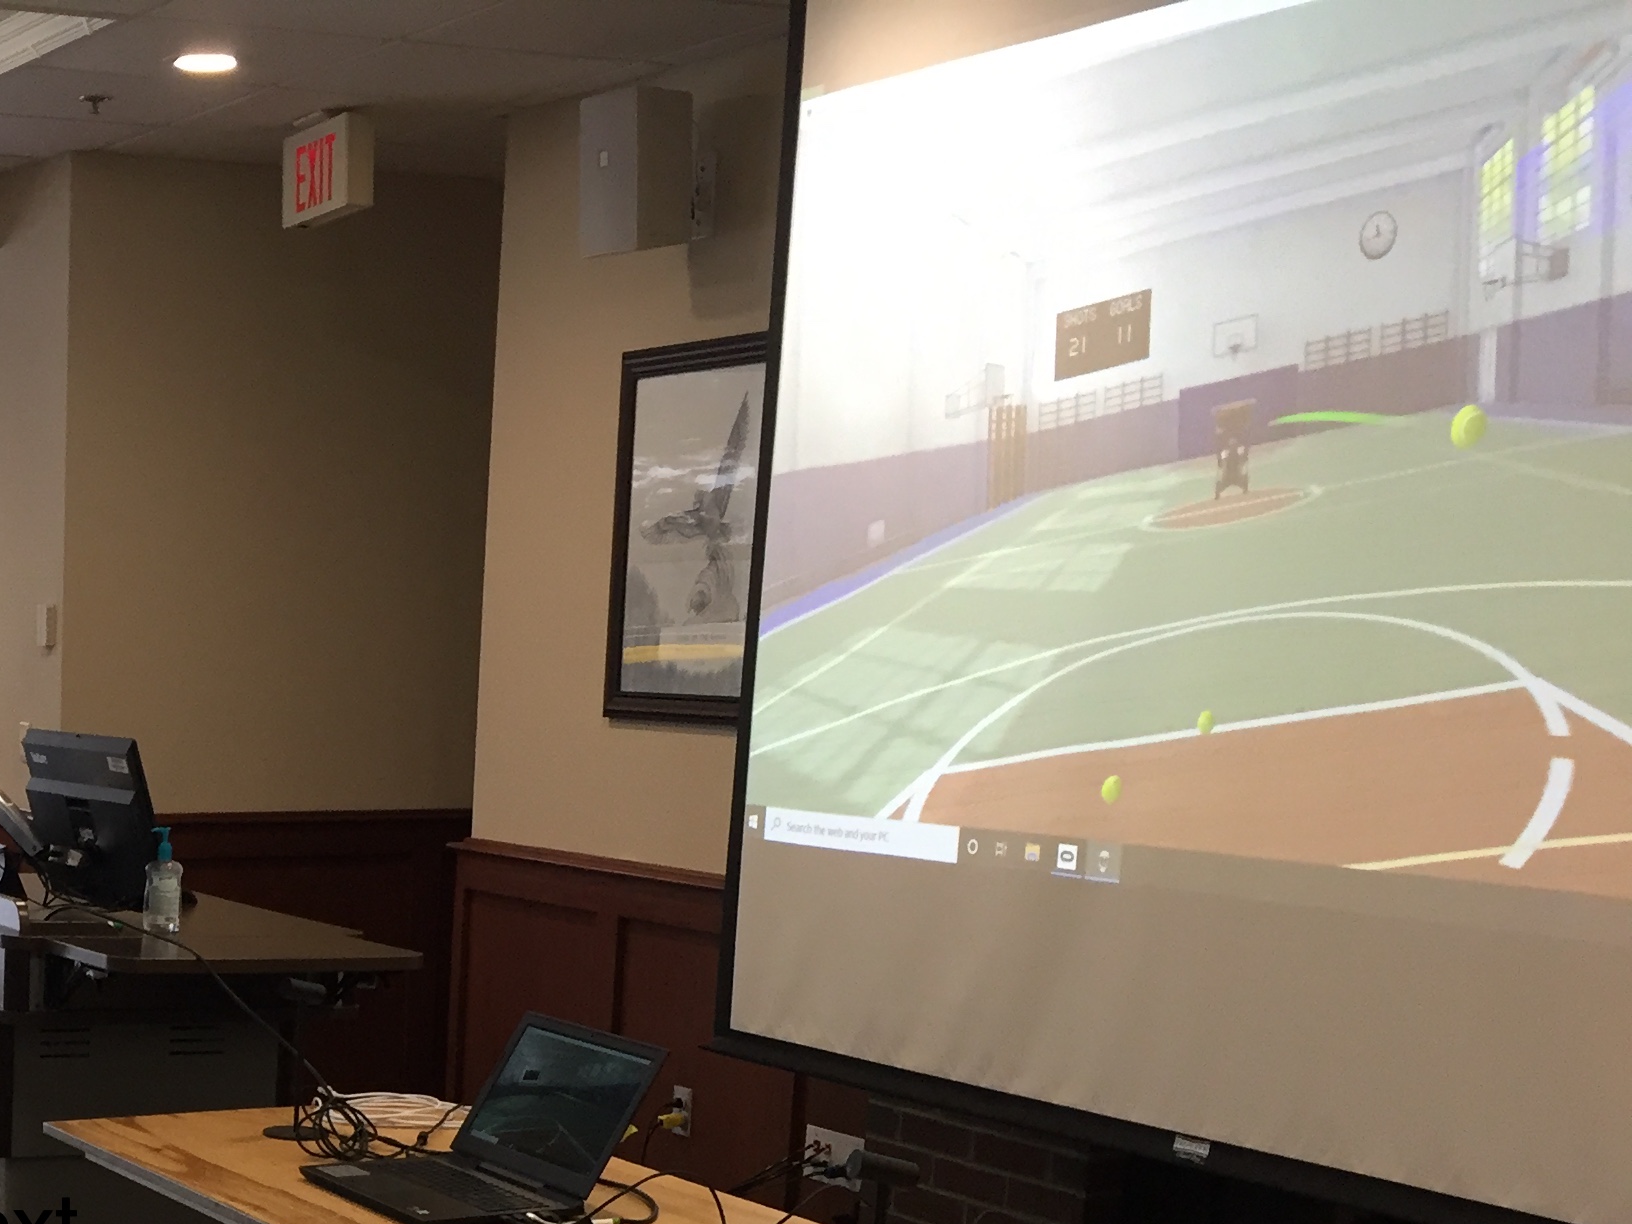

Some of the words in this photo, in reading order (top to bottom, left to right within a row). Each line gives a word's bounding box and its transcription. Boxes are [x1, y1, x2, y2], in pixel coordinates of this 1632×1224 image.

[295, 132, 337, 214] EXIT
[1069, 336, 1086, 357] 21
[1118, 324, 1132, 344] 11
[786, 821, 812, 832] Search
[844, 828, 859, 840] and
